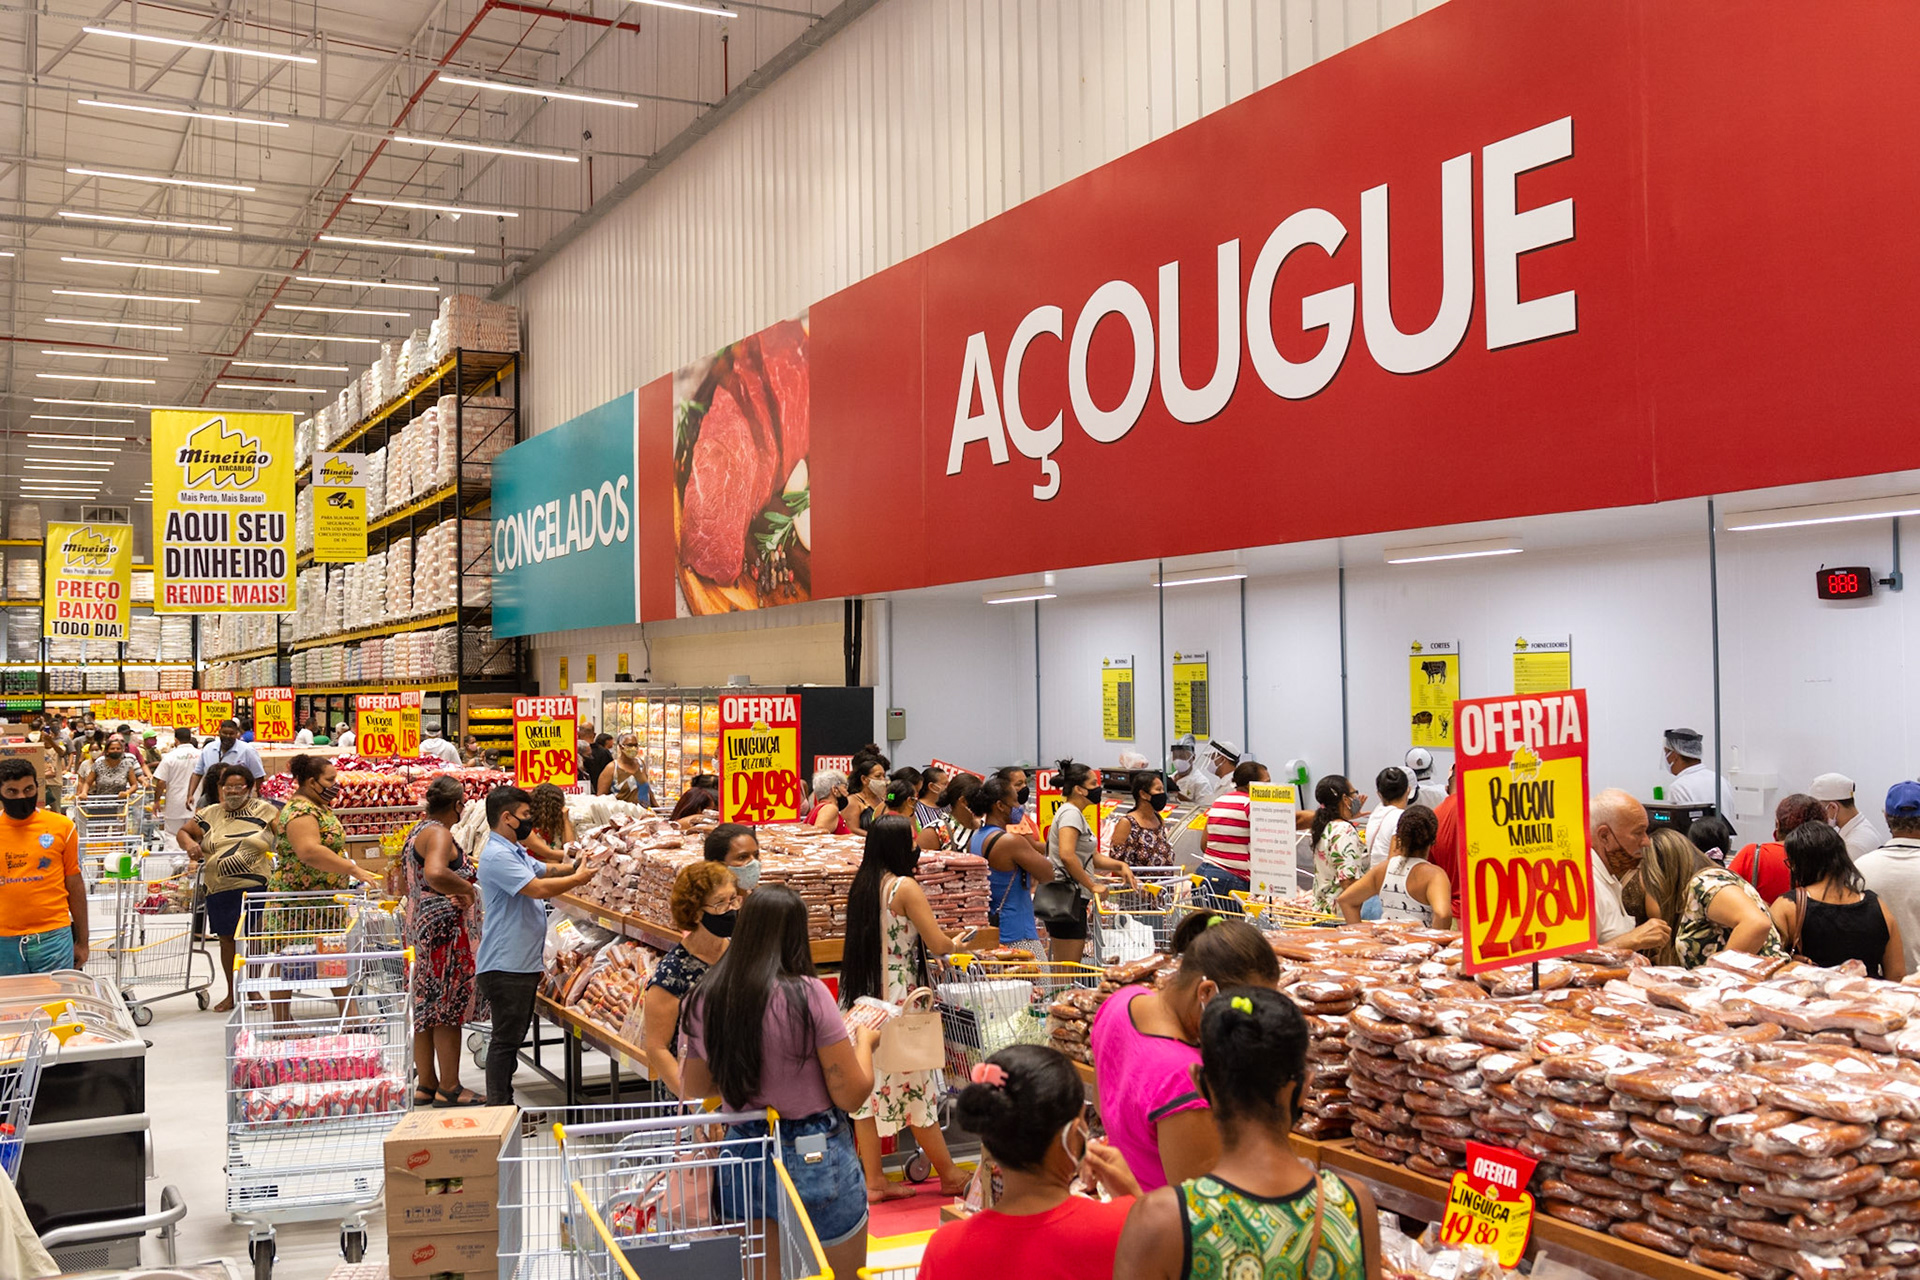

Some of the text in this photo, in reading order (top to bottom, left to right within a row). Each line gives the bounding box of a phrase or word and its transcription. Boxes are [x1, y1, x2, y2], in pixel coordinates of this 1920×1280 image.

[946, 114, 1579, 501] AÇOUGUE
[179, 449, 268, 464] Mineirão
[320, 468, 359, 476] Mineirão
[181, 493, 264, 503] Mais Perto, Mais Barato!
[166, 512, 284, 542] AQUI SEU
[494, 474, 630, 573] CONGELADOS
[63, 543, 117, 553] Mineirão
[166, 548, 285, 578] DINHEIRO
[57, 581, 120, 601] PREÇO
[1828, 573, 1858, 594] 888
[167, 585, 285, 604] RENDE MAIS!
[59, 602, 116, 620] BAIXO
[52, 621, 122, 637] TODO DIA!
[151, 693, 171, 701] OFERT
[171, 690, 199, 699] OFERTA
[201, 691, 232, 701] OFERTA
[255, 689, 292, 700] OFERTA
[358, 696, 400, 709] OFERTA
[401, 691, 419, 705] OFERTA
[516, 698, 575, 717] OFERTA
[723, 697, 797, 723] OFERTA
[258, 721, 290, 739] 7,48
[525, 726, 562, 740] ORELHA
[1460, 695, 1583, 757] OFERTA
[728, 736, 780, 760] LINGUIÇA
[520, 749, 576, 784] 15,98
[741, 757, 773, 771] REZENDE
[816, 756, 854, 772] OFERT
[731, 769, 798, 822] 24,98
[1251, 788, 1271, 799] Prezado
[1489, 776, 1555, 826] BACON
[1508, 823, 1554, 846] MANTA
[1475, 857, 1587, 959] 22,80
[408, 1153, 429, 1166] Soya
[1473, 1157, 1518, 1189] OFERTA
[1450, 1186, 1510, 1224] LINGUIÇA
[413, 1249, 435, 1261] Soya
